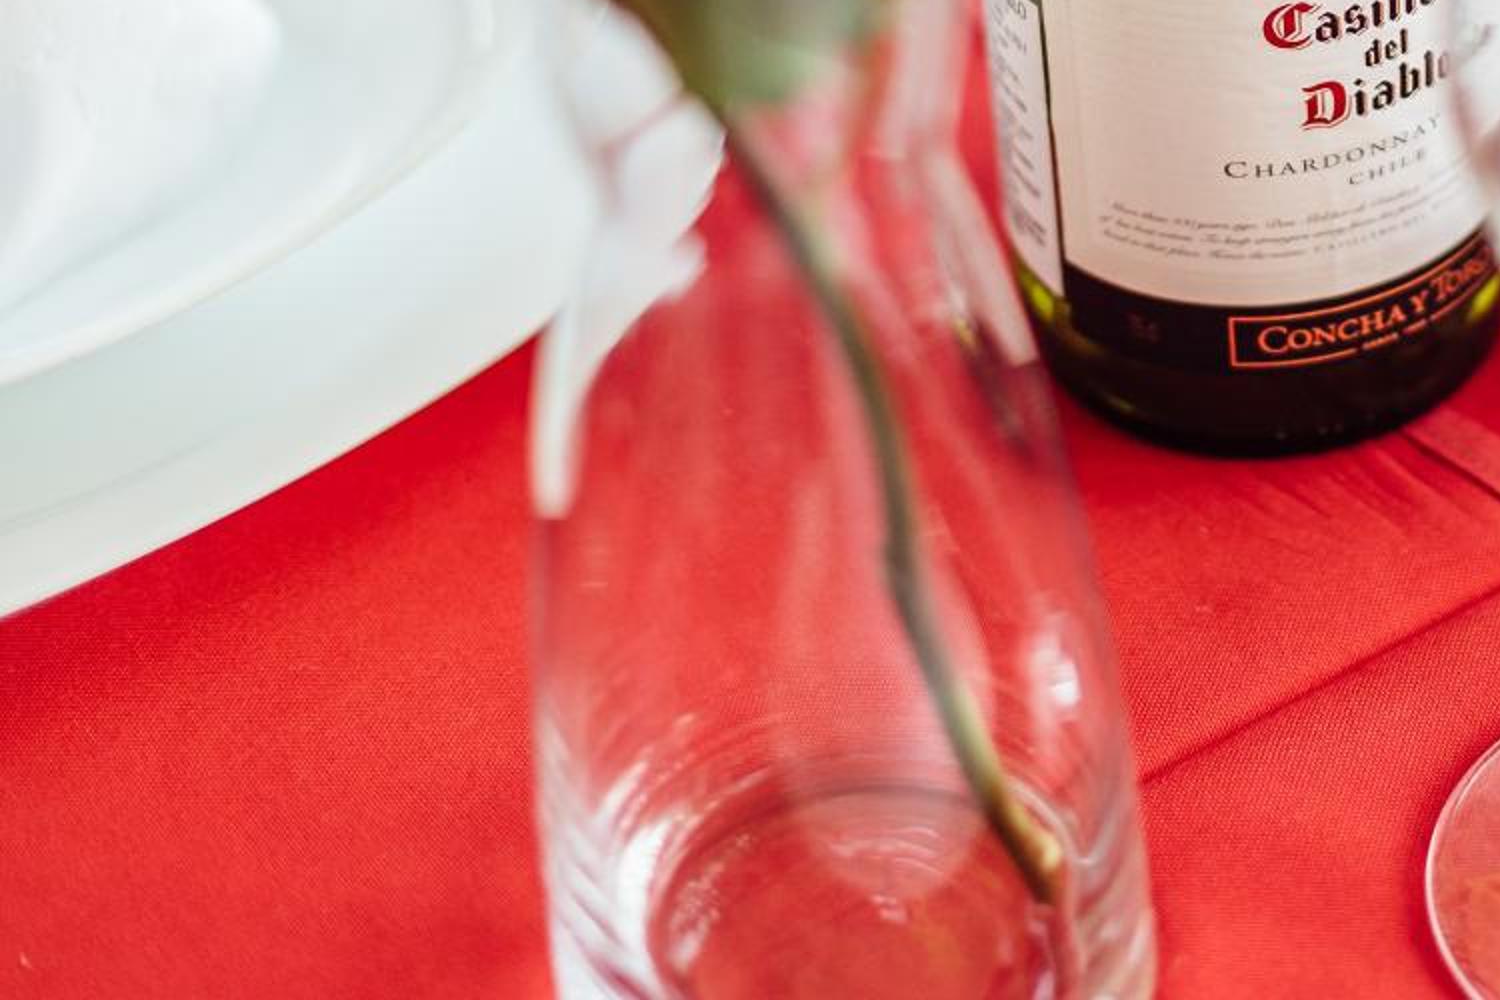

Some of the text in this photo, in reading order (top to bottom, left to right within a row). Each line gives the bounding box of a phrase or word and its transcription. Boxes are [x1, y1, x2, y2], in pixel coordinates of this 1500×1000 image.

[1363, 26, 1409, 68] del
[1222, 111, 1441, 180] CHARDONNAY
[1348, 147, 1428, 186] CHILE
[1257, 303, 1407, 354] CONCHA
